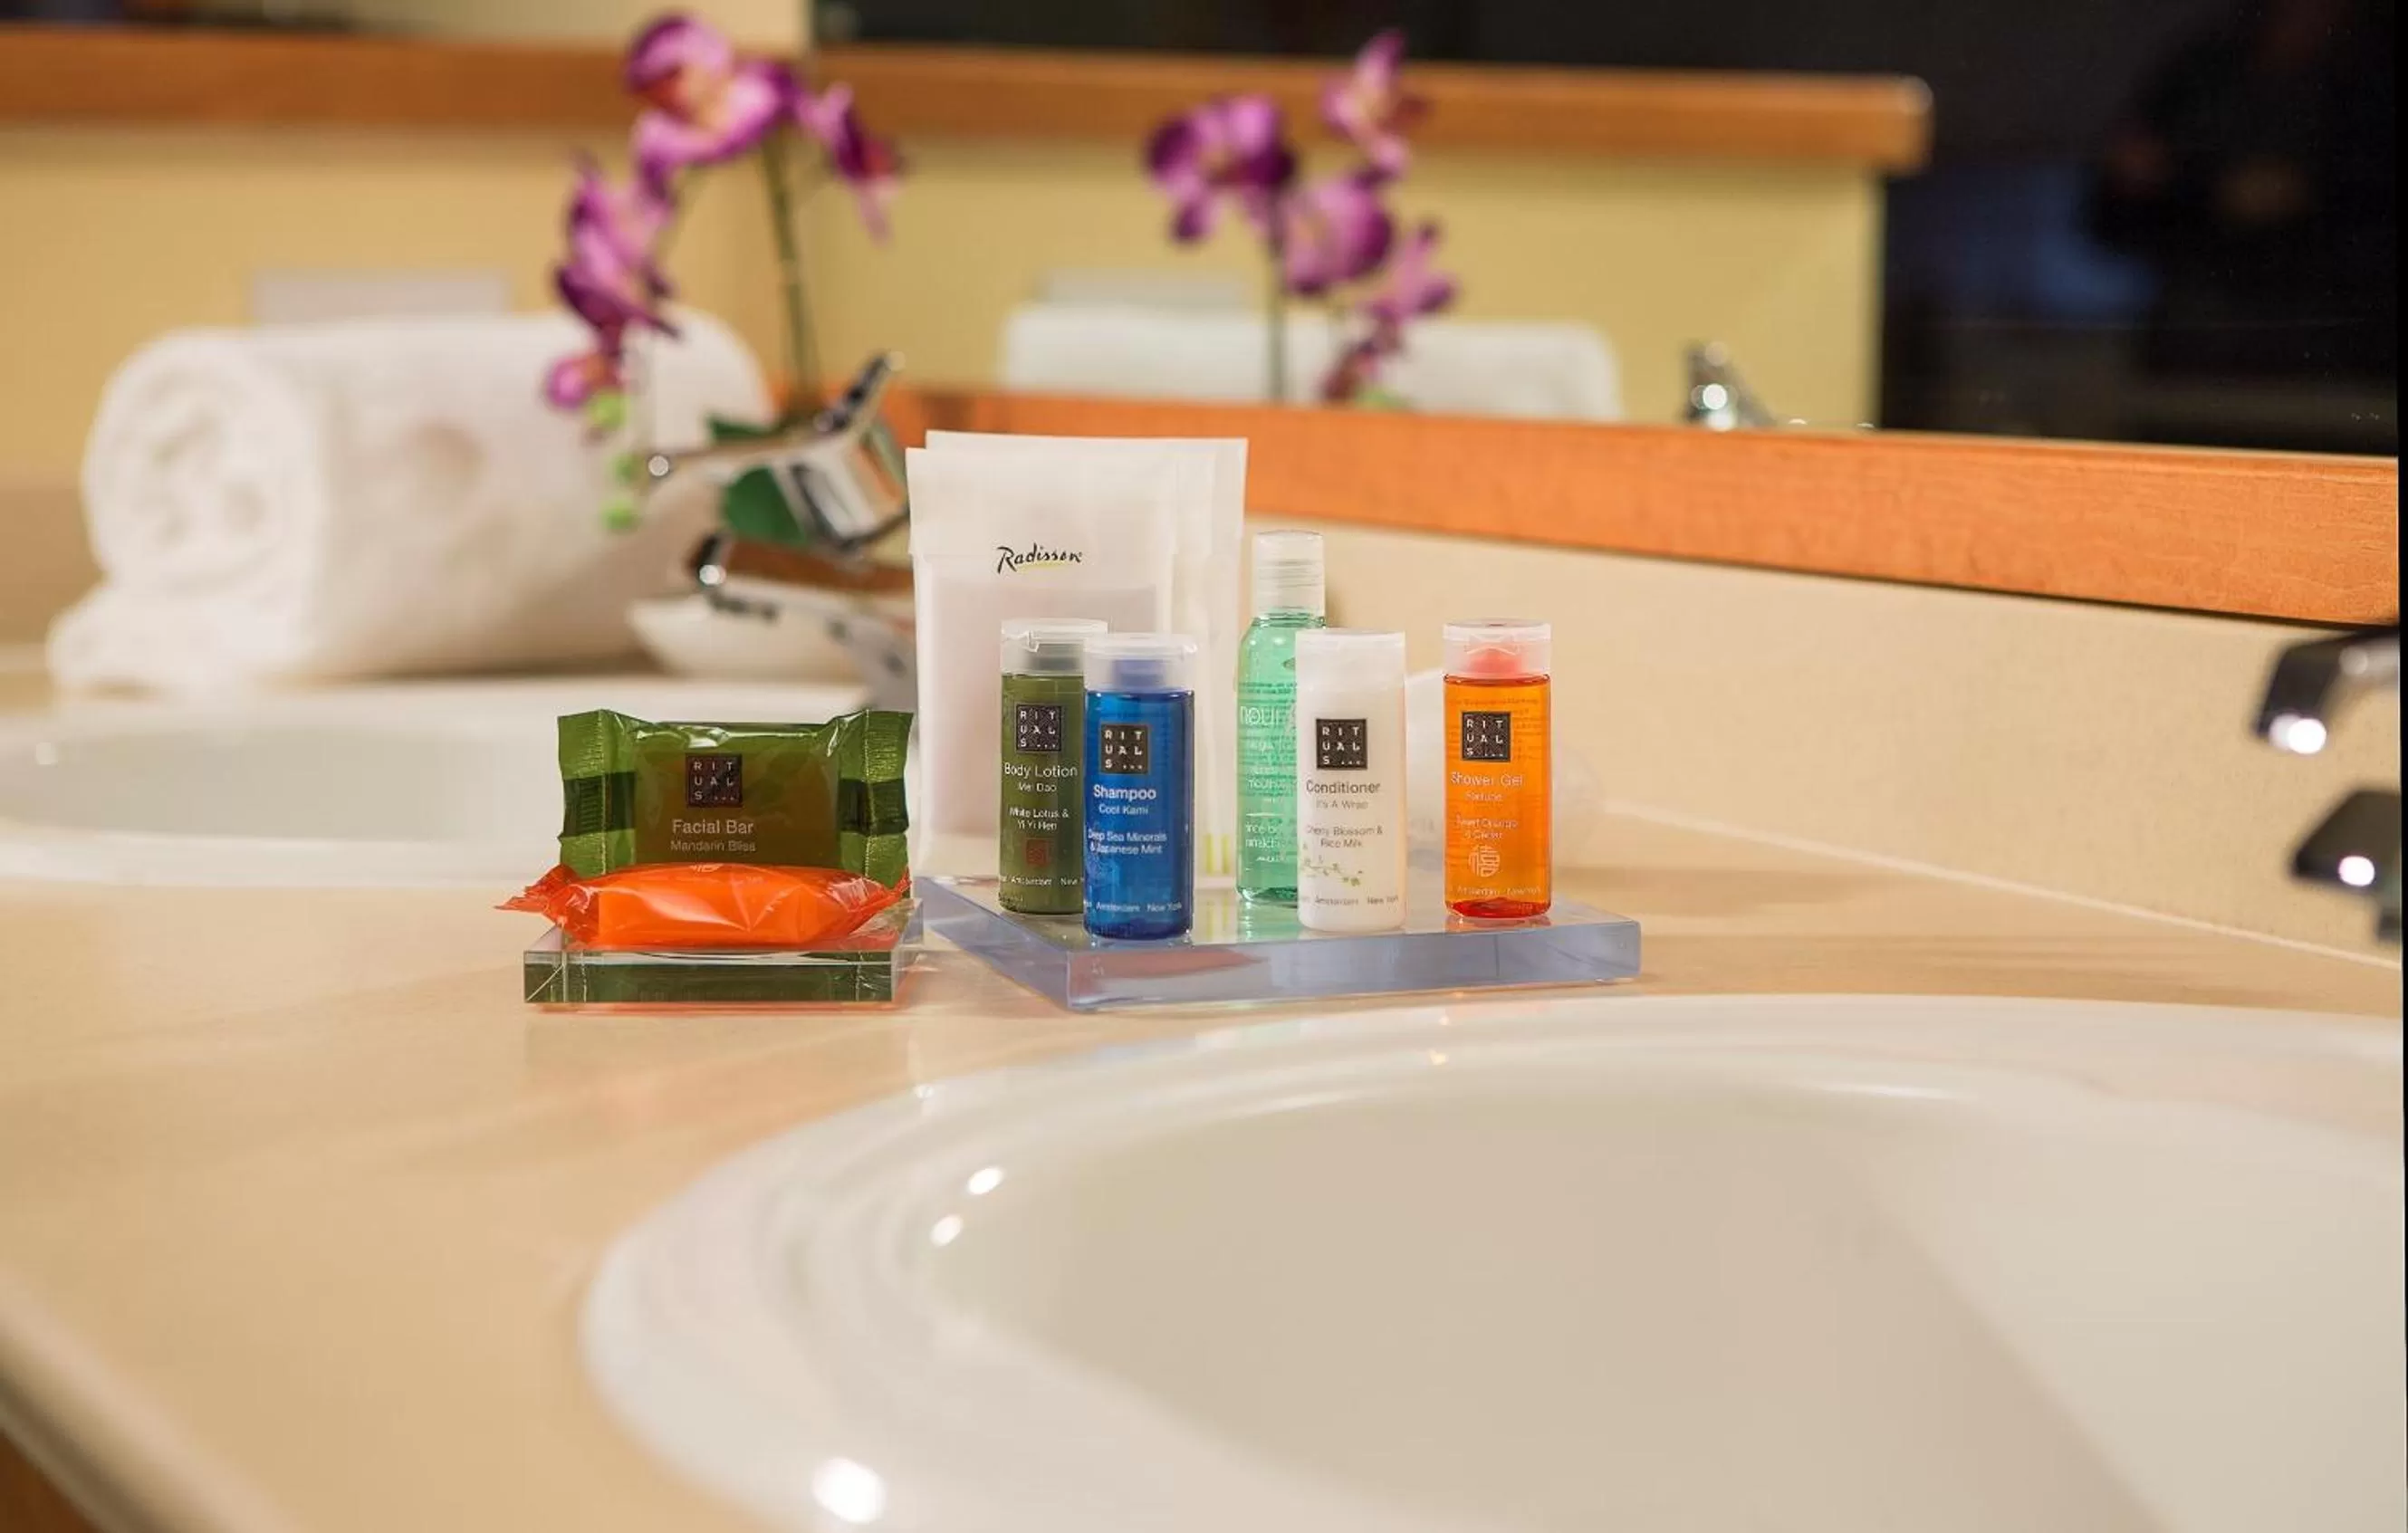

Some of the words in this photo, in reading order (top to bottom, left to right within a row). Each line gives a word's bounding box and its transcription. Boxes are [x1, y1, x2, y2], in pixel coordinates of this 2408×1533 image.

[997, 542, 1081, 574] Radisson
[1004, 762, 1031, 779] Body
[1035, 765, 1078, 778] Lotion
[1451, 771, 1493, 786] Shower
[1500, 773, 1523, 787] Gel
[1093, 783, 1157, 802] Shampoo
[1306, 779, 1381, 794] Conditioner
[1033, 809, 1060, 819] Lotus
[1061, 808, 1070, 819] &
[1098, 803, 1120, 815] Cool
[1123, 804, 1149, 815] Kami
[672, 819, 721, 834] Facial
[726, 819, 754, 834] Bar
[1107, 831, 1125, 842] Sea
[670, 840, 724, 852] Mandarin
[1096, 843, 1139, 855] Japanese
[1141, 844, 1163, 854] Mint
[1096, 902, 1141, 912] Amsterdam
[1146, 904, 1166, 912] New
